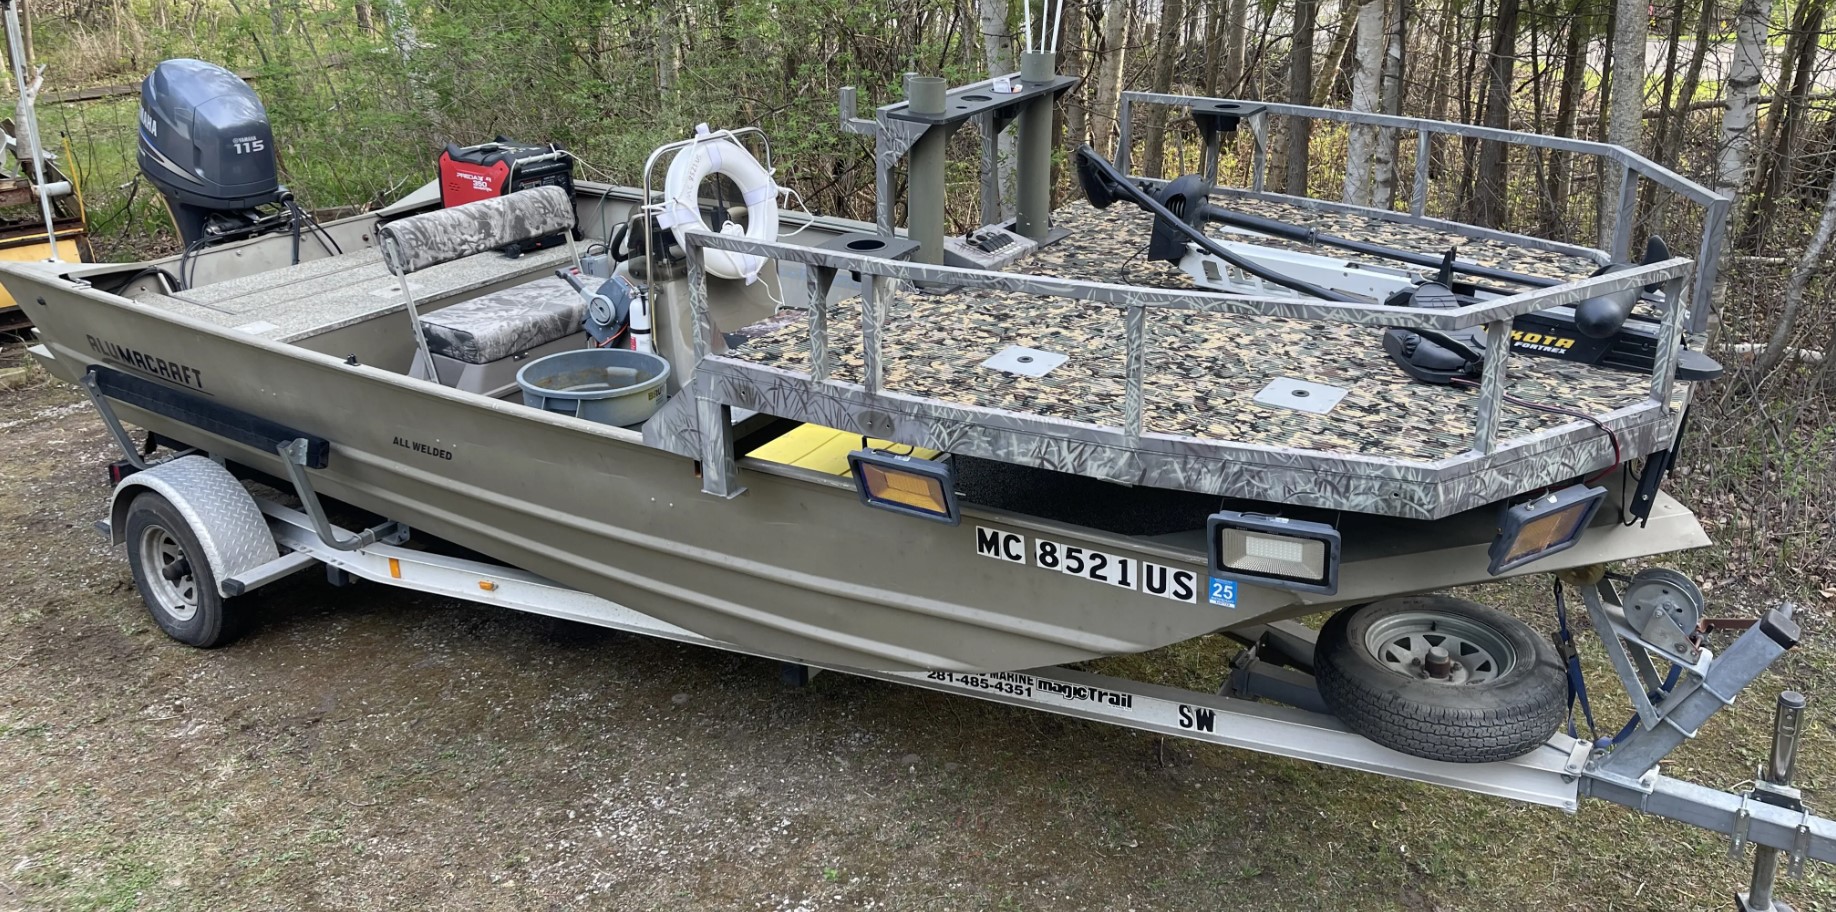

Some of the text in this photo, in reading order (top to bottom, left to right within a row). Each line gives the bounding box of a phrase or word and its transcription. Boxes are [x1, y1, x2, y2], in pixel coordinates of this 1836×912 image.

[233, 139, 265, 154] 115
[1514, 341, 1567, 354] FORTREX
[86, 334, 202, 388] ALUMACRAFT
[393, 436, 453, 461] ALL WELDED
[977, 528, 1193, 600] MC 8521 US
[1212, 582, 1233, 600] 25
[927, 671, 1033, 698] 281-485-4351
[989, 672, 1034, 686] MARINE
[1178, 704, 1215, 732] SW
